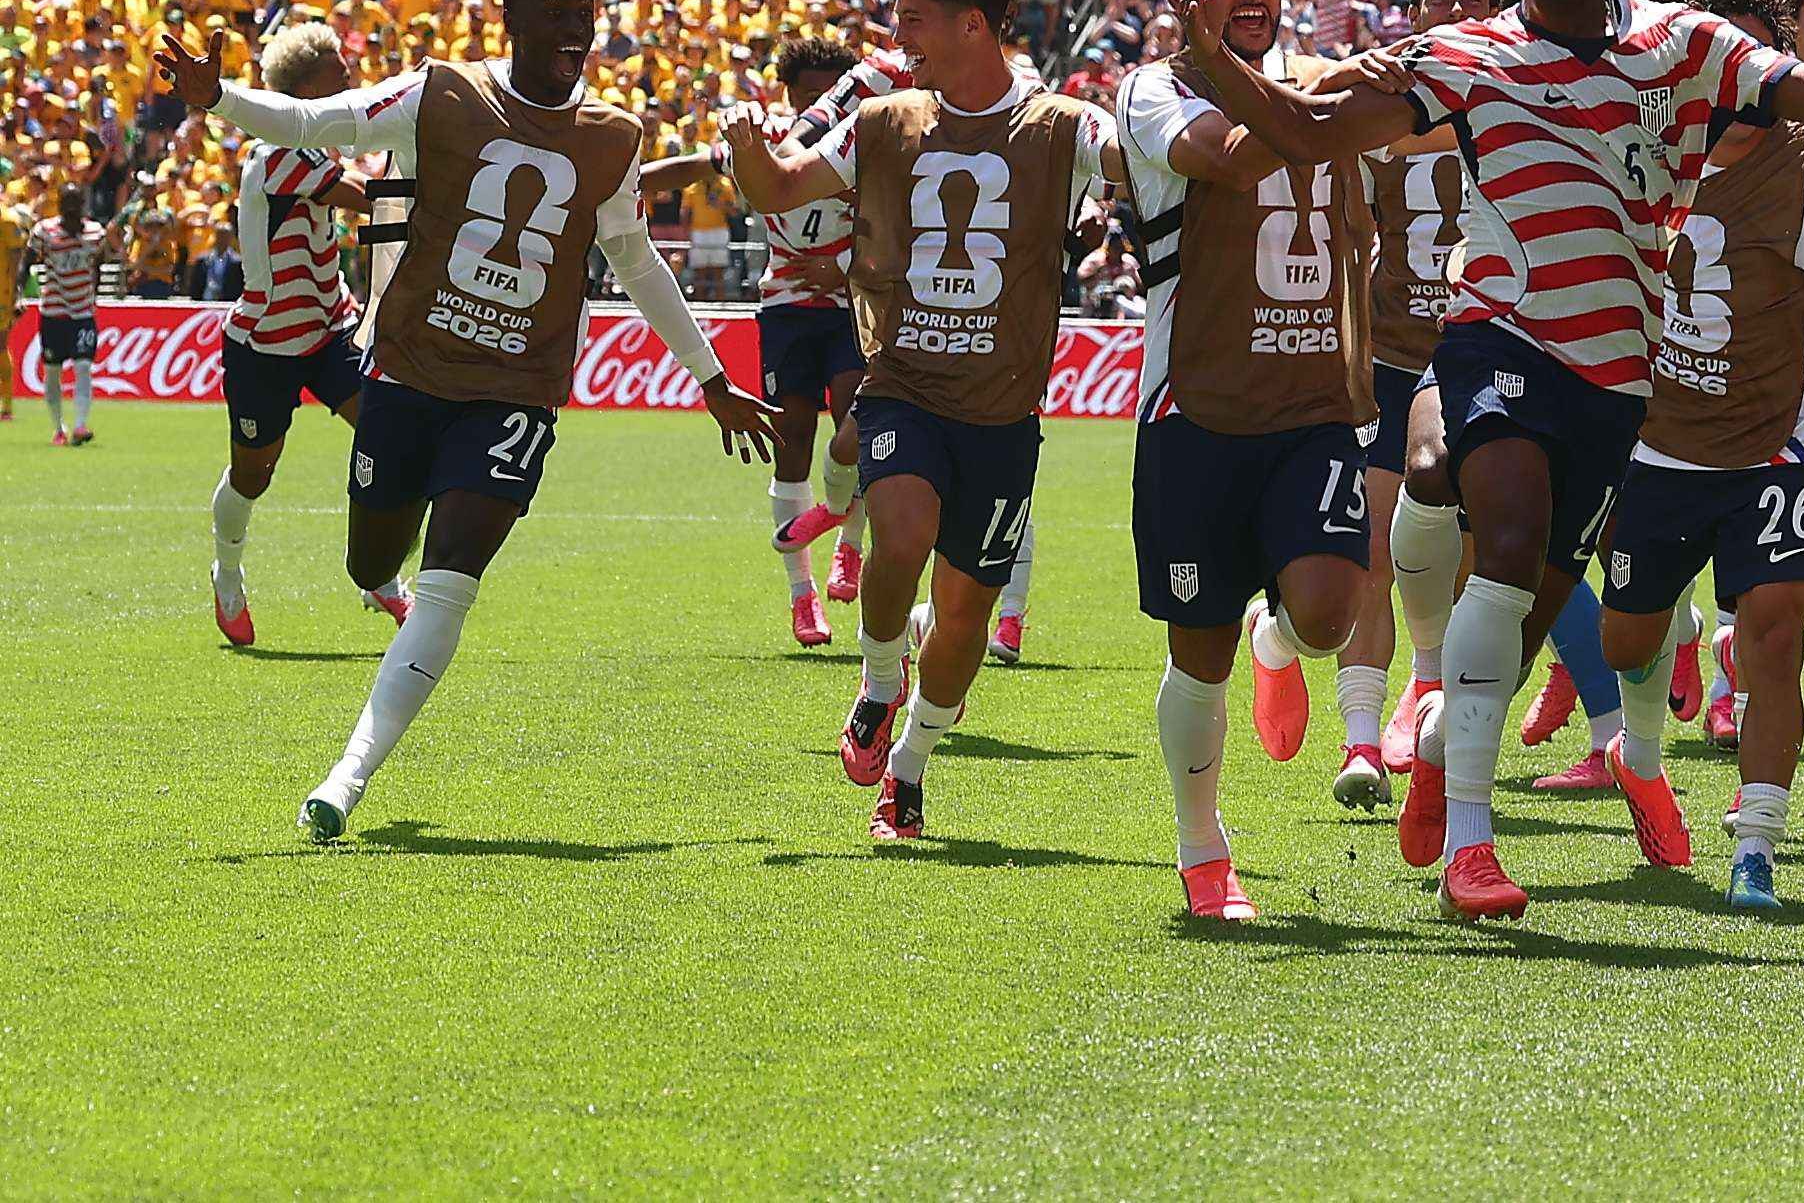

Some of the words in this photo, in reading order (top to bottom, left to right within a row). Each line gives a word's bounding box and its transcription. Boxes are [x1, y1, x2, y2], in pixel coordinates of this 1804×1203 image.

[1640, 89, 1669, 110] USA
[802, 209, 822, 243] 4
[474, 266, 519, 293] FIFA
[932, 277, 976, 294] FIFA
[1285, 265, 1320, 284] FIFA
[436, 289, 497, 321] WORLD
[499, 313, 532, 330] CUP
[902, 308, 961, 329] WORLD
[964, 315, 998, 330] CUP
[1254, 307, 1310, 325] WORLD
[1313, 307, 1333, 324] CUP
[1409, 298, 1450, 318] 20
[427, 306, 527, 355] 2026
[1670, 317, 1702, 339] FIFA
[77, 330, 95, 351] 20
[896, 326, 995, 354] 2026
[1251, 327, 1338, 355] 2026
[1657, 342, 1691, 367] ORLD
[1694, 354, 1731, 374] CUP
[1497, 372, 1523, 384] USA
[1654, 356, 1727, 396] 026
[488, 411, 547, 469] 21
[357, 452, 374, 469] USA
[1319, 459, 1366, 520] 15
[982, 497, 1030, 551] 14
[1613, 552, 1630, 569] USA
[1172, 565, 1197, 581] USA
